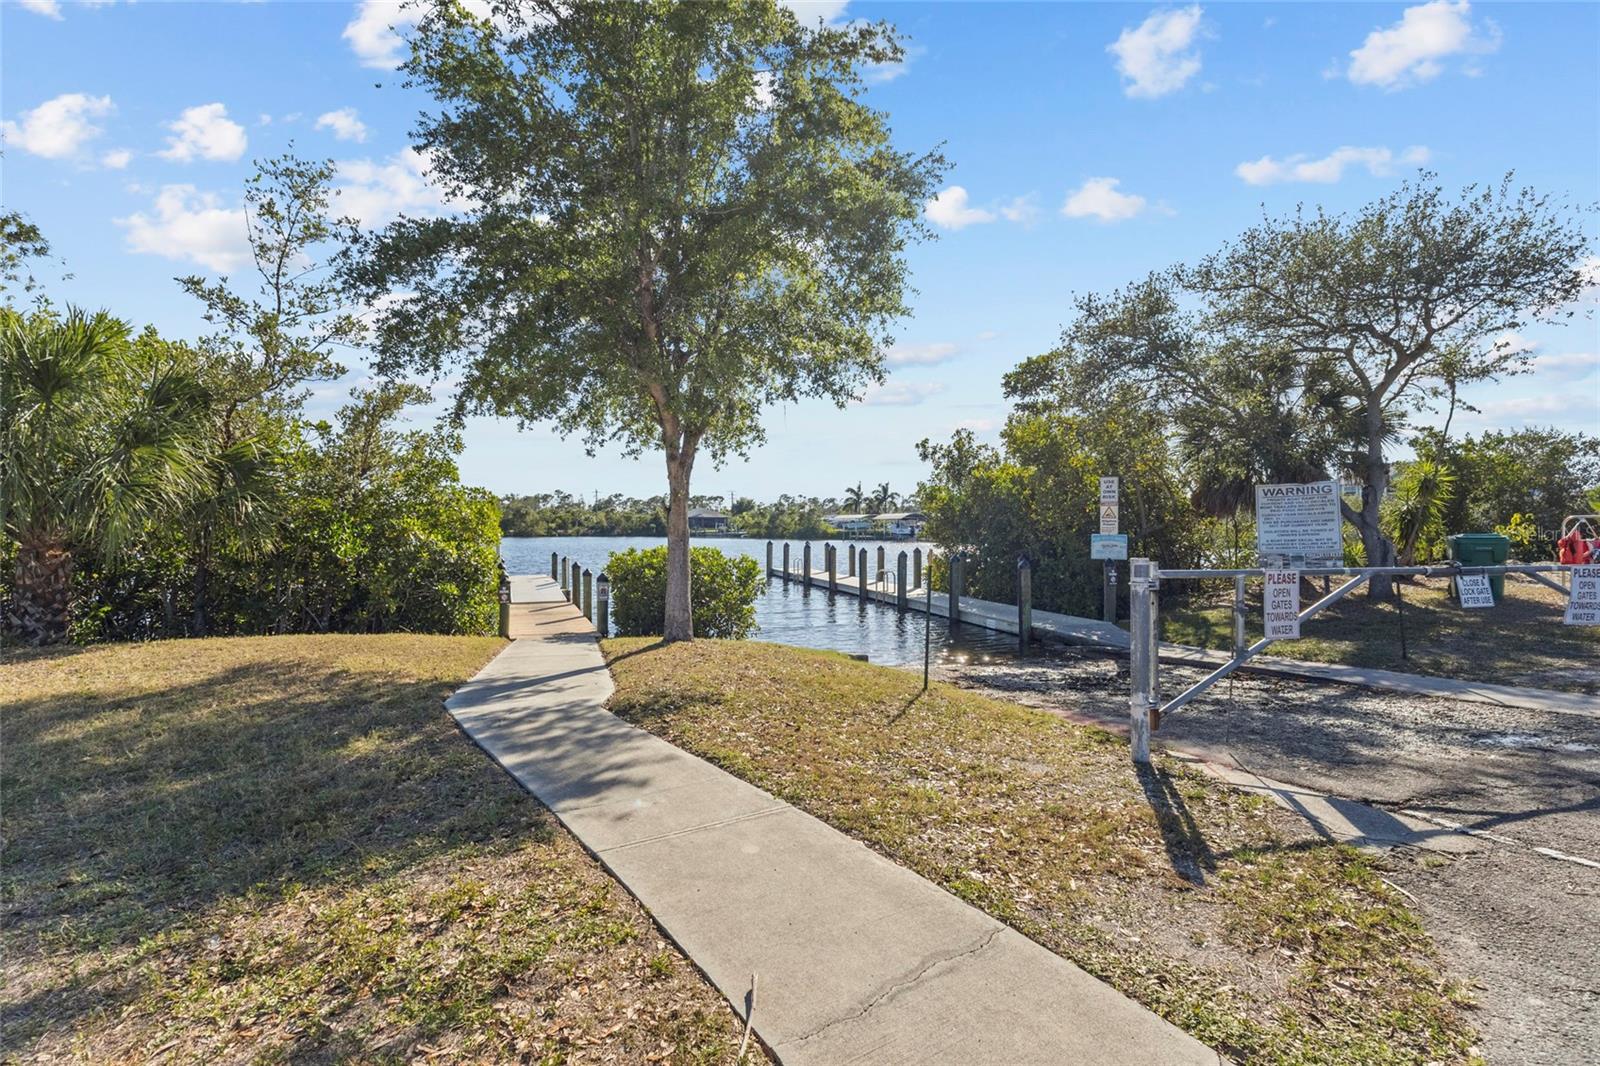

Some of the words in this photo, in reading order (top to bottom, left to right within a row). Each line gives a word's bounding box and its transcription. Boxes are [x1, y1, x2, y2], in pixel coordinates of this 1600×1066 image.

[1262, 485, 1332, 496] WARNING
[1573, 568, 1600, 578] PLEASE
[1268, 573, 1296, 584] PLEASE
[1579, 581, 1596, 589] OPEN
[1272, 588, 1291, 598] OPEN
[1577, 592, 1597, 600] GATES
[1271, 600, 1292, 610] GATES
[1570, 601, 1600, 610] TOWARDS
[1266, 612, 1297, 622] TOWARDS
[1572, 612, 1596, 621] WATER
[1271, 625, 1294, 635] WATER
